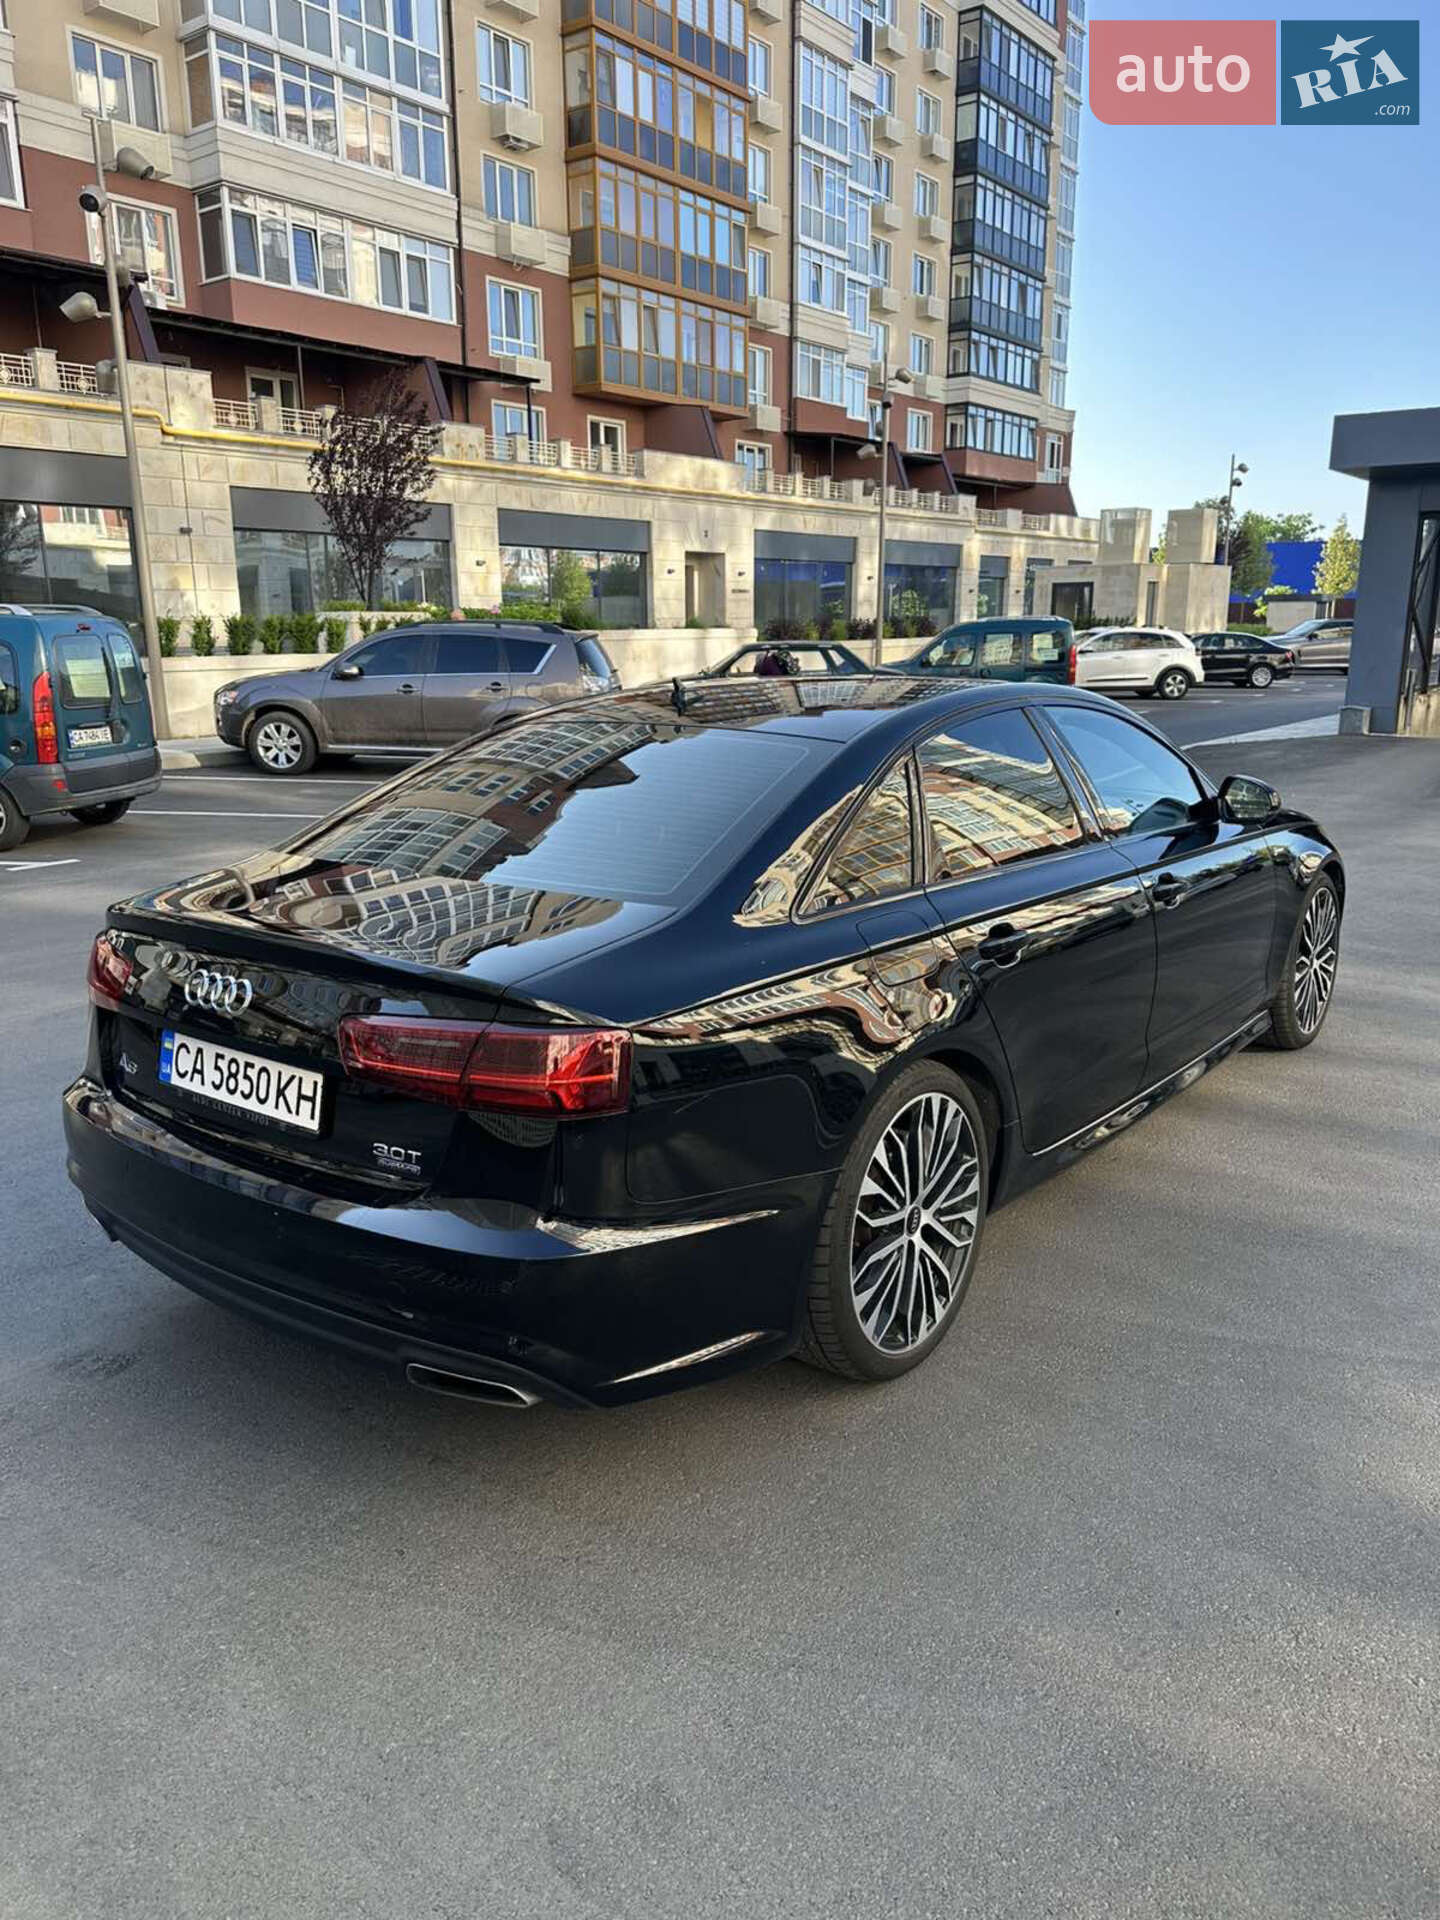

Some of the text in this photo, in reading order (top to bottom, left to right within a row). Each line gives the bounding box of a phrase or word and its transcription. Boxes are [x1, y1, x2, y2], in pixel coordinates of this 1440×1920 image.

[174, 1041, 320, 1121] CA 5850 KH
